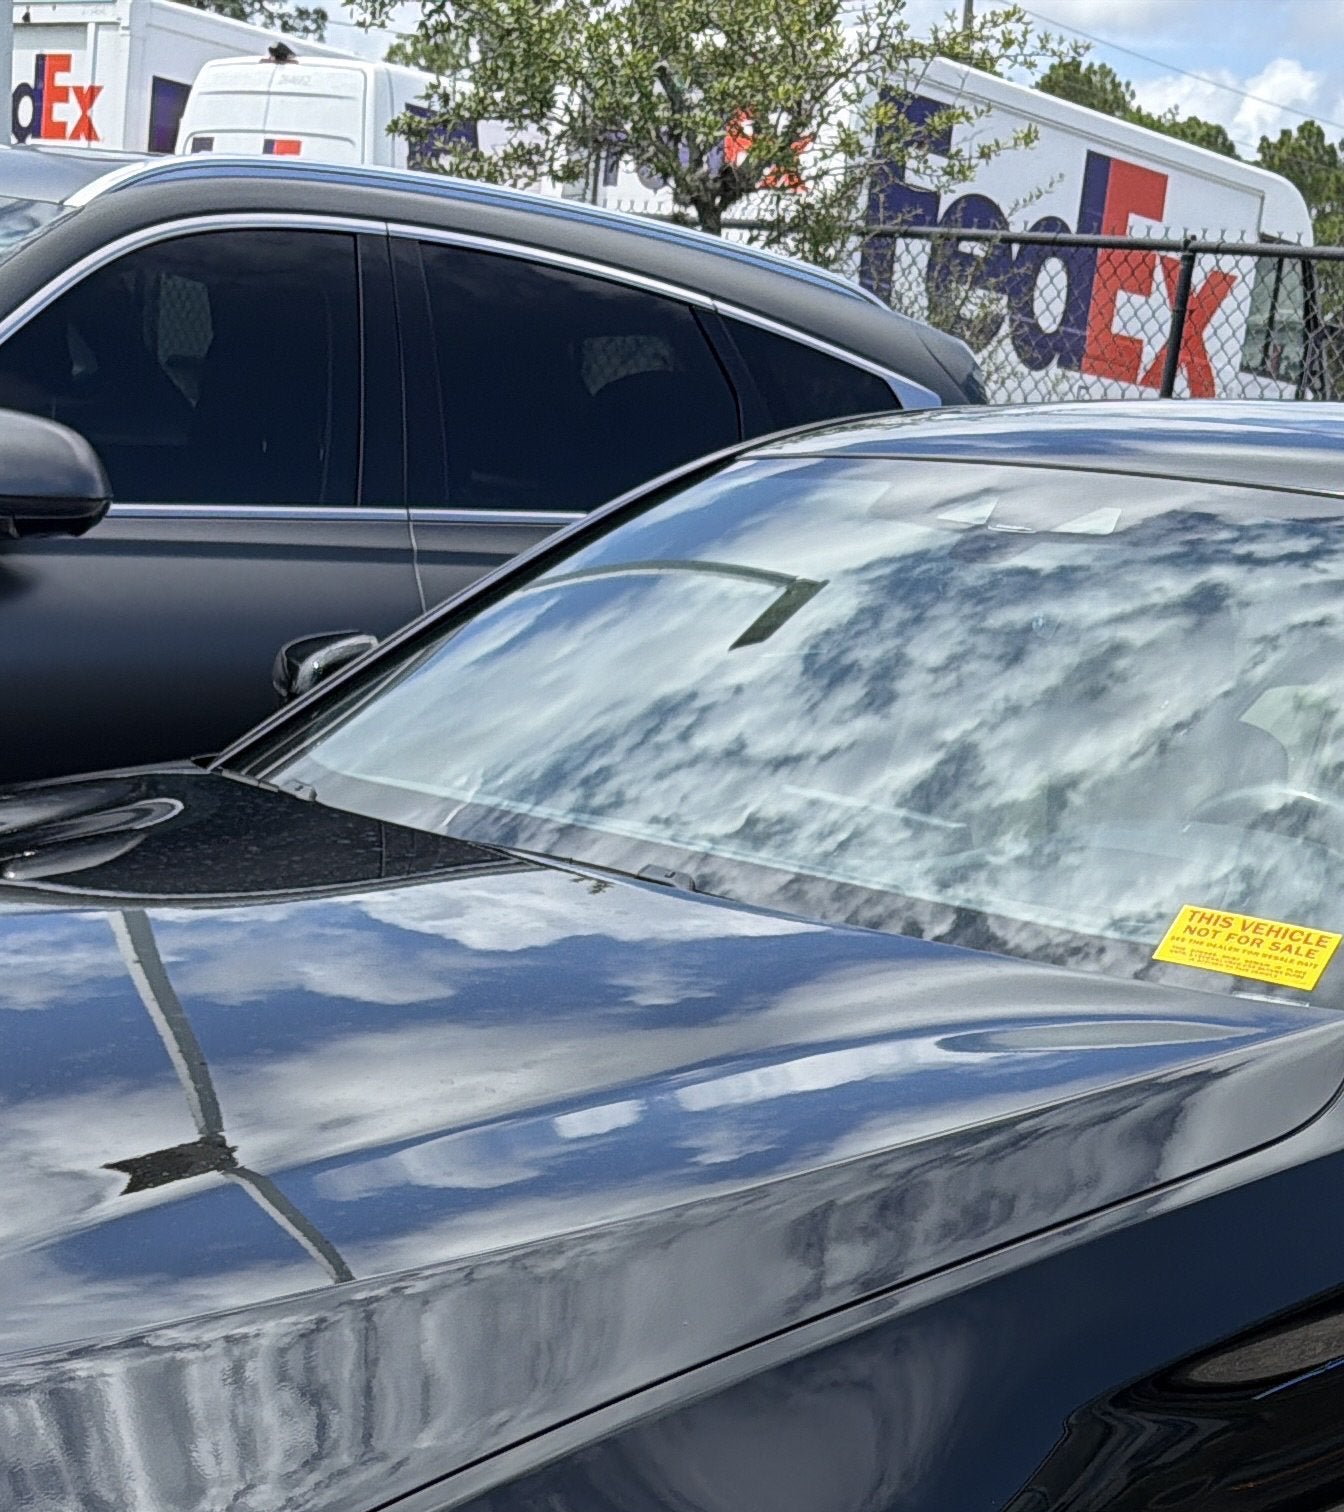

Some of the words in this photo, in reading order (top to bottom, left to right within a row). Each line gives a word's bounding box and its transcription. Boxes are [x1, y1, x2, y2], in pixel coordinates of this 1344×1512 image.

[1183, 924, 1223, 940] NOT
[1225, 932, 1265, 949] FOR
[1268, 941, 1320, 960] SALE
[1187, 910, 1234, 929] THIS
[1241, 919, 1332, 949] VEHICLE
